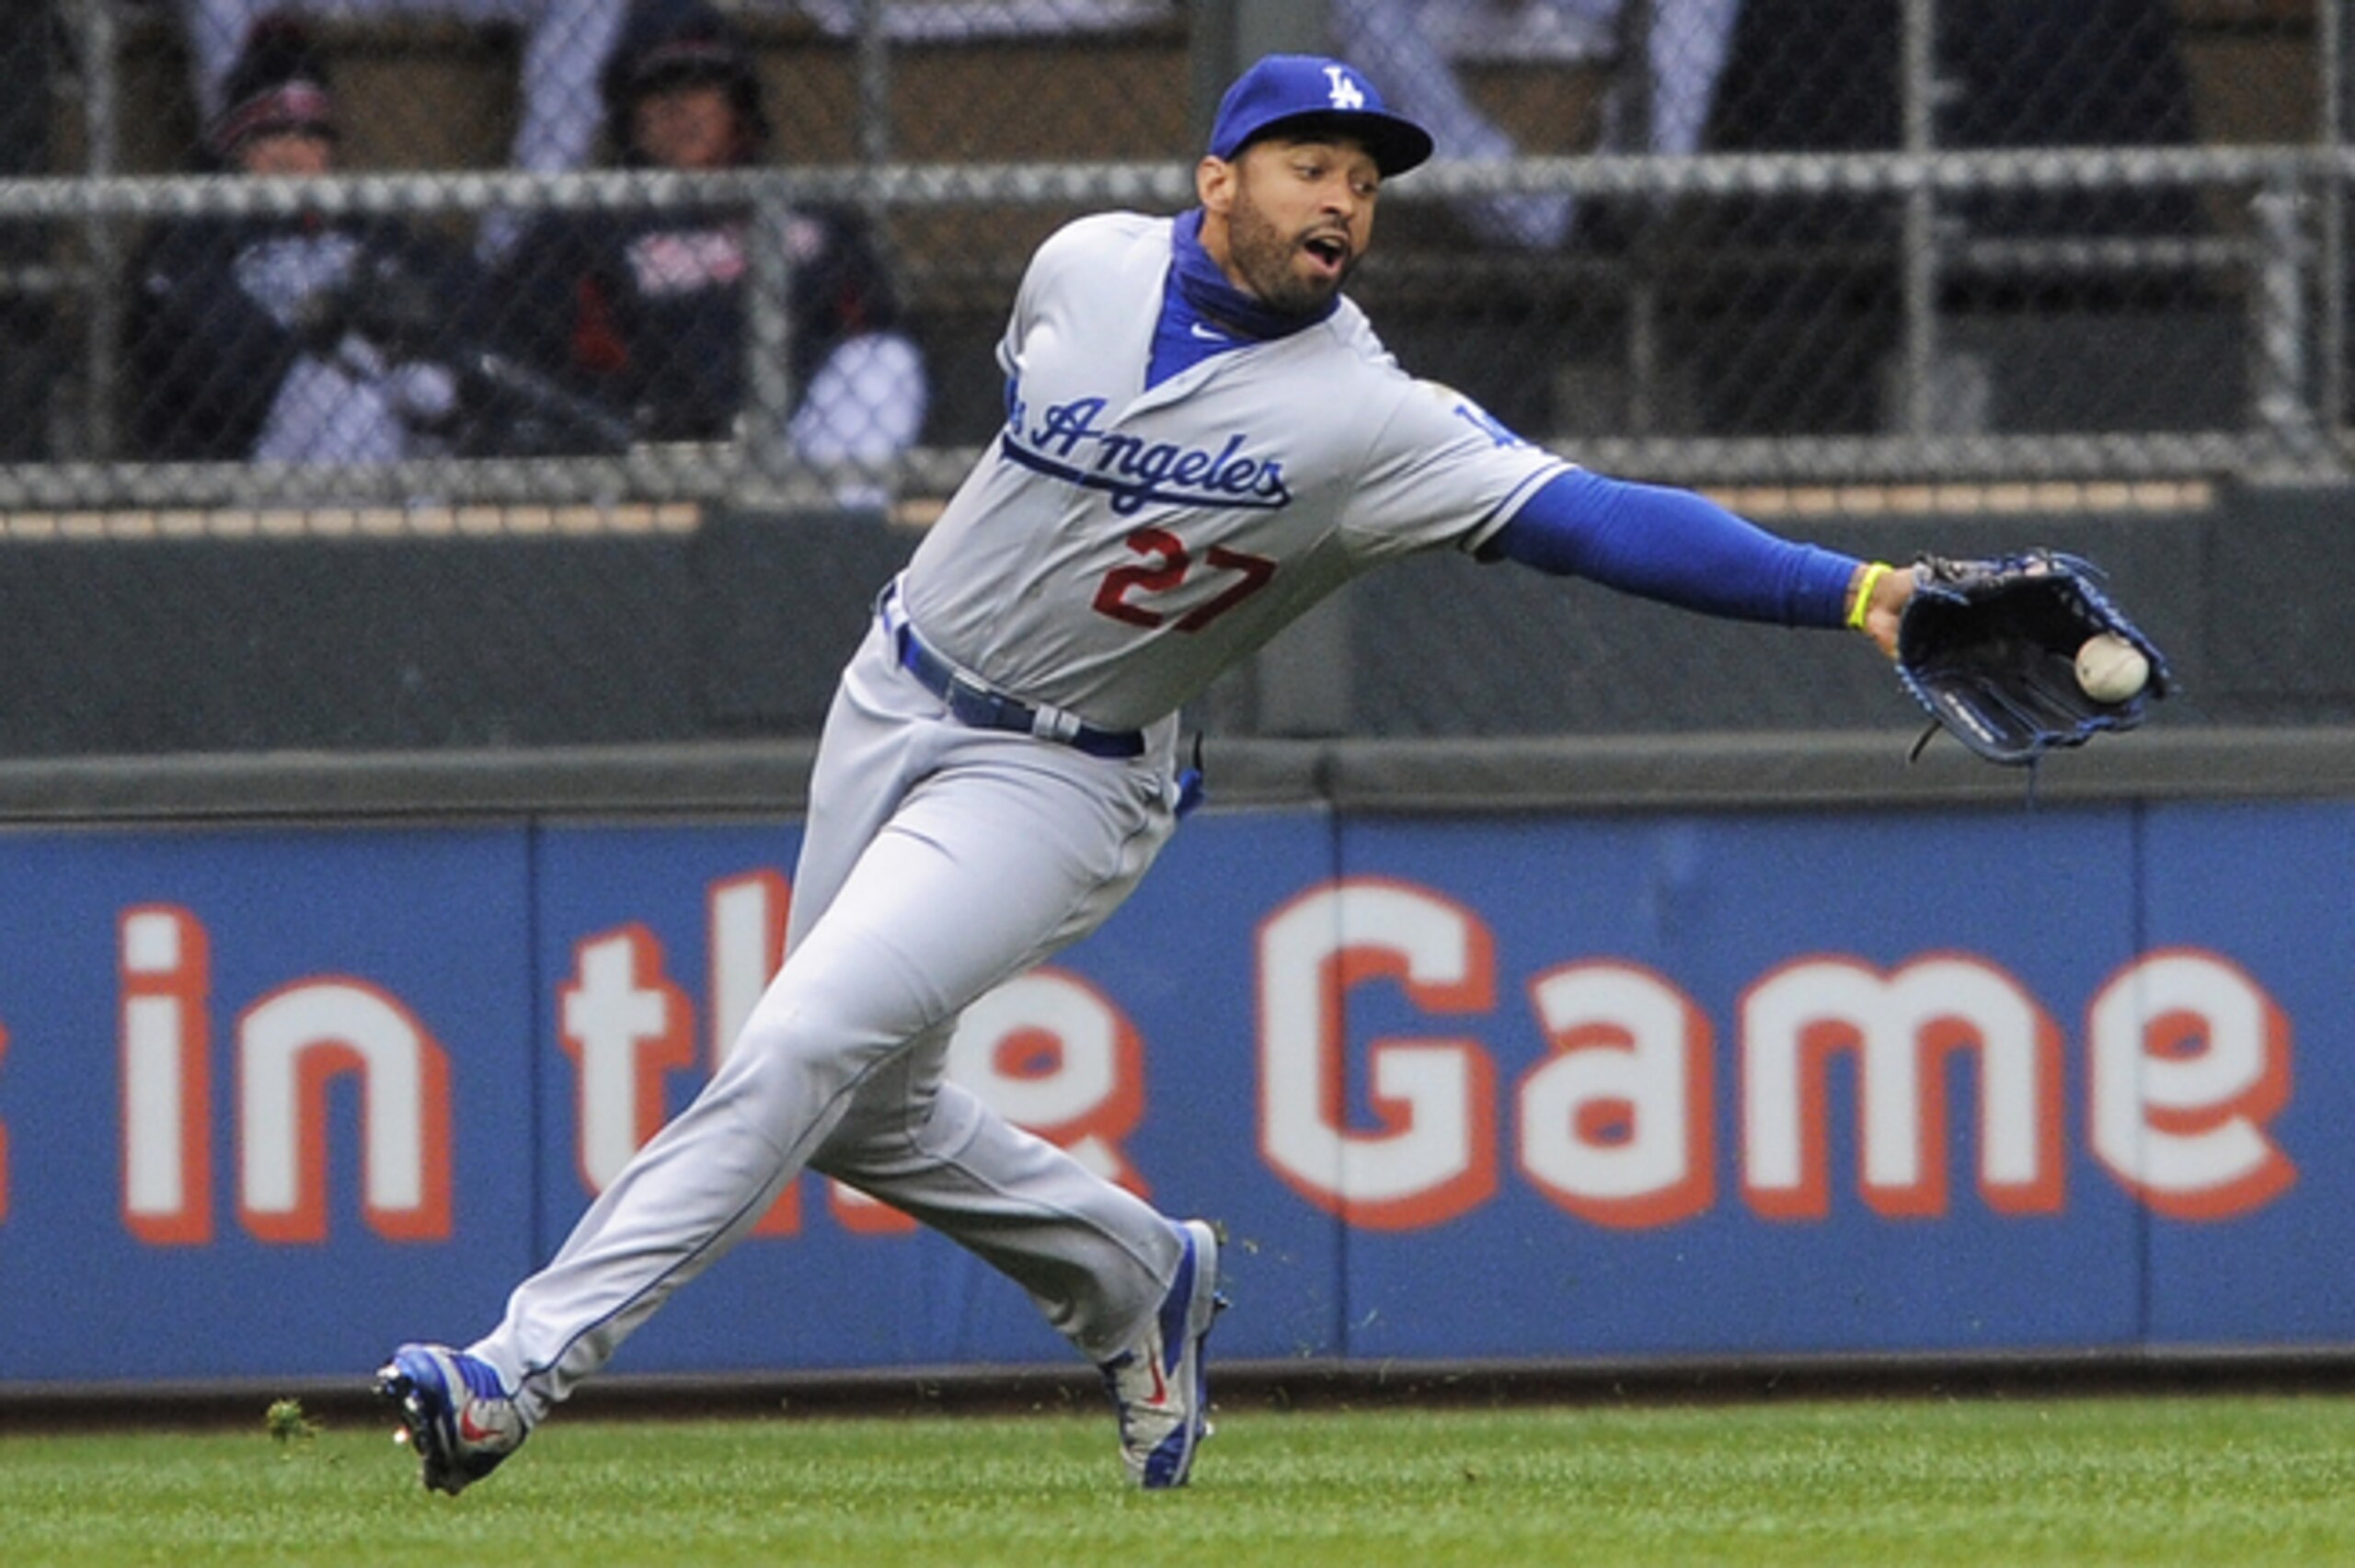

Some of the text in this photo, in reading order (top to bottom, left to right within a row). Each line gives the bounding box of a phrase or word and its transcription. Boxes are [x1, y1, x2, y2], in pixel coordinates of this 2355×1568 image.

[1322, 65, 1364, 109] LA
[1030, 396, 1288, 515] Angeles
[1091, 527, 1278, 633] 27
[120, 902, 454, 1245] in
[1254, 874, 2299, 1233] Game
